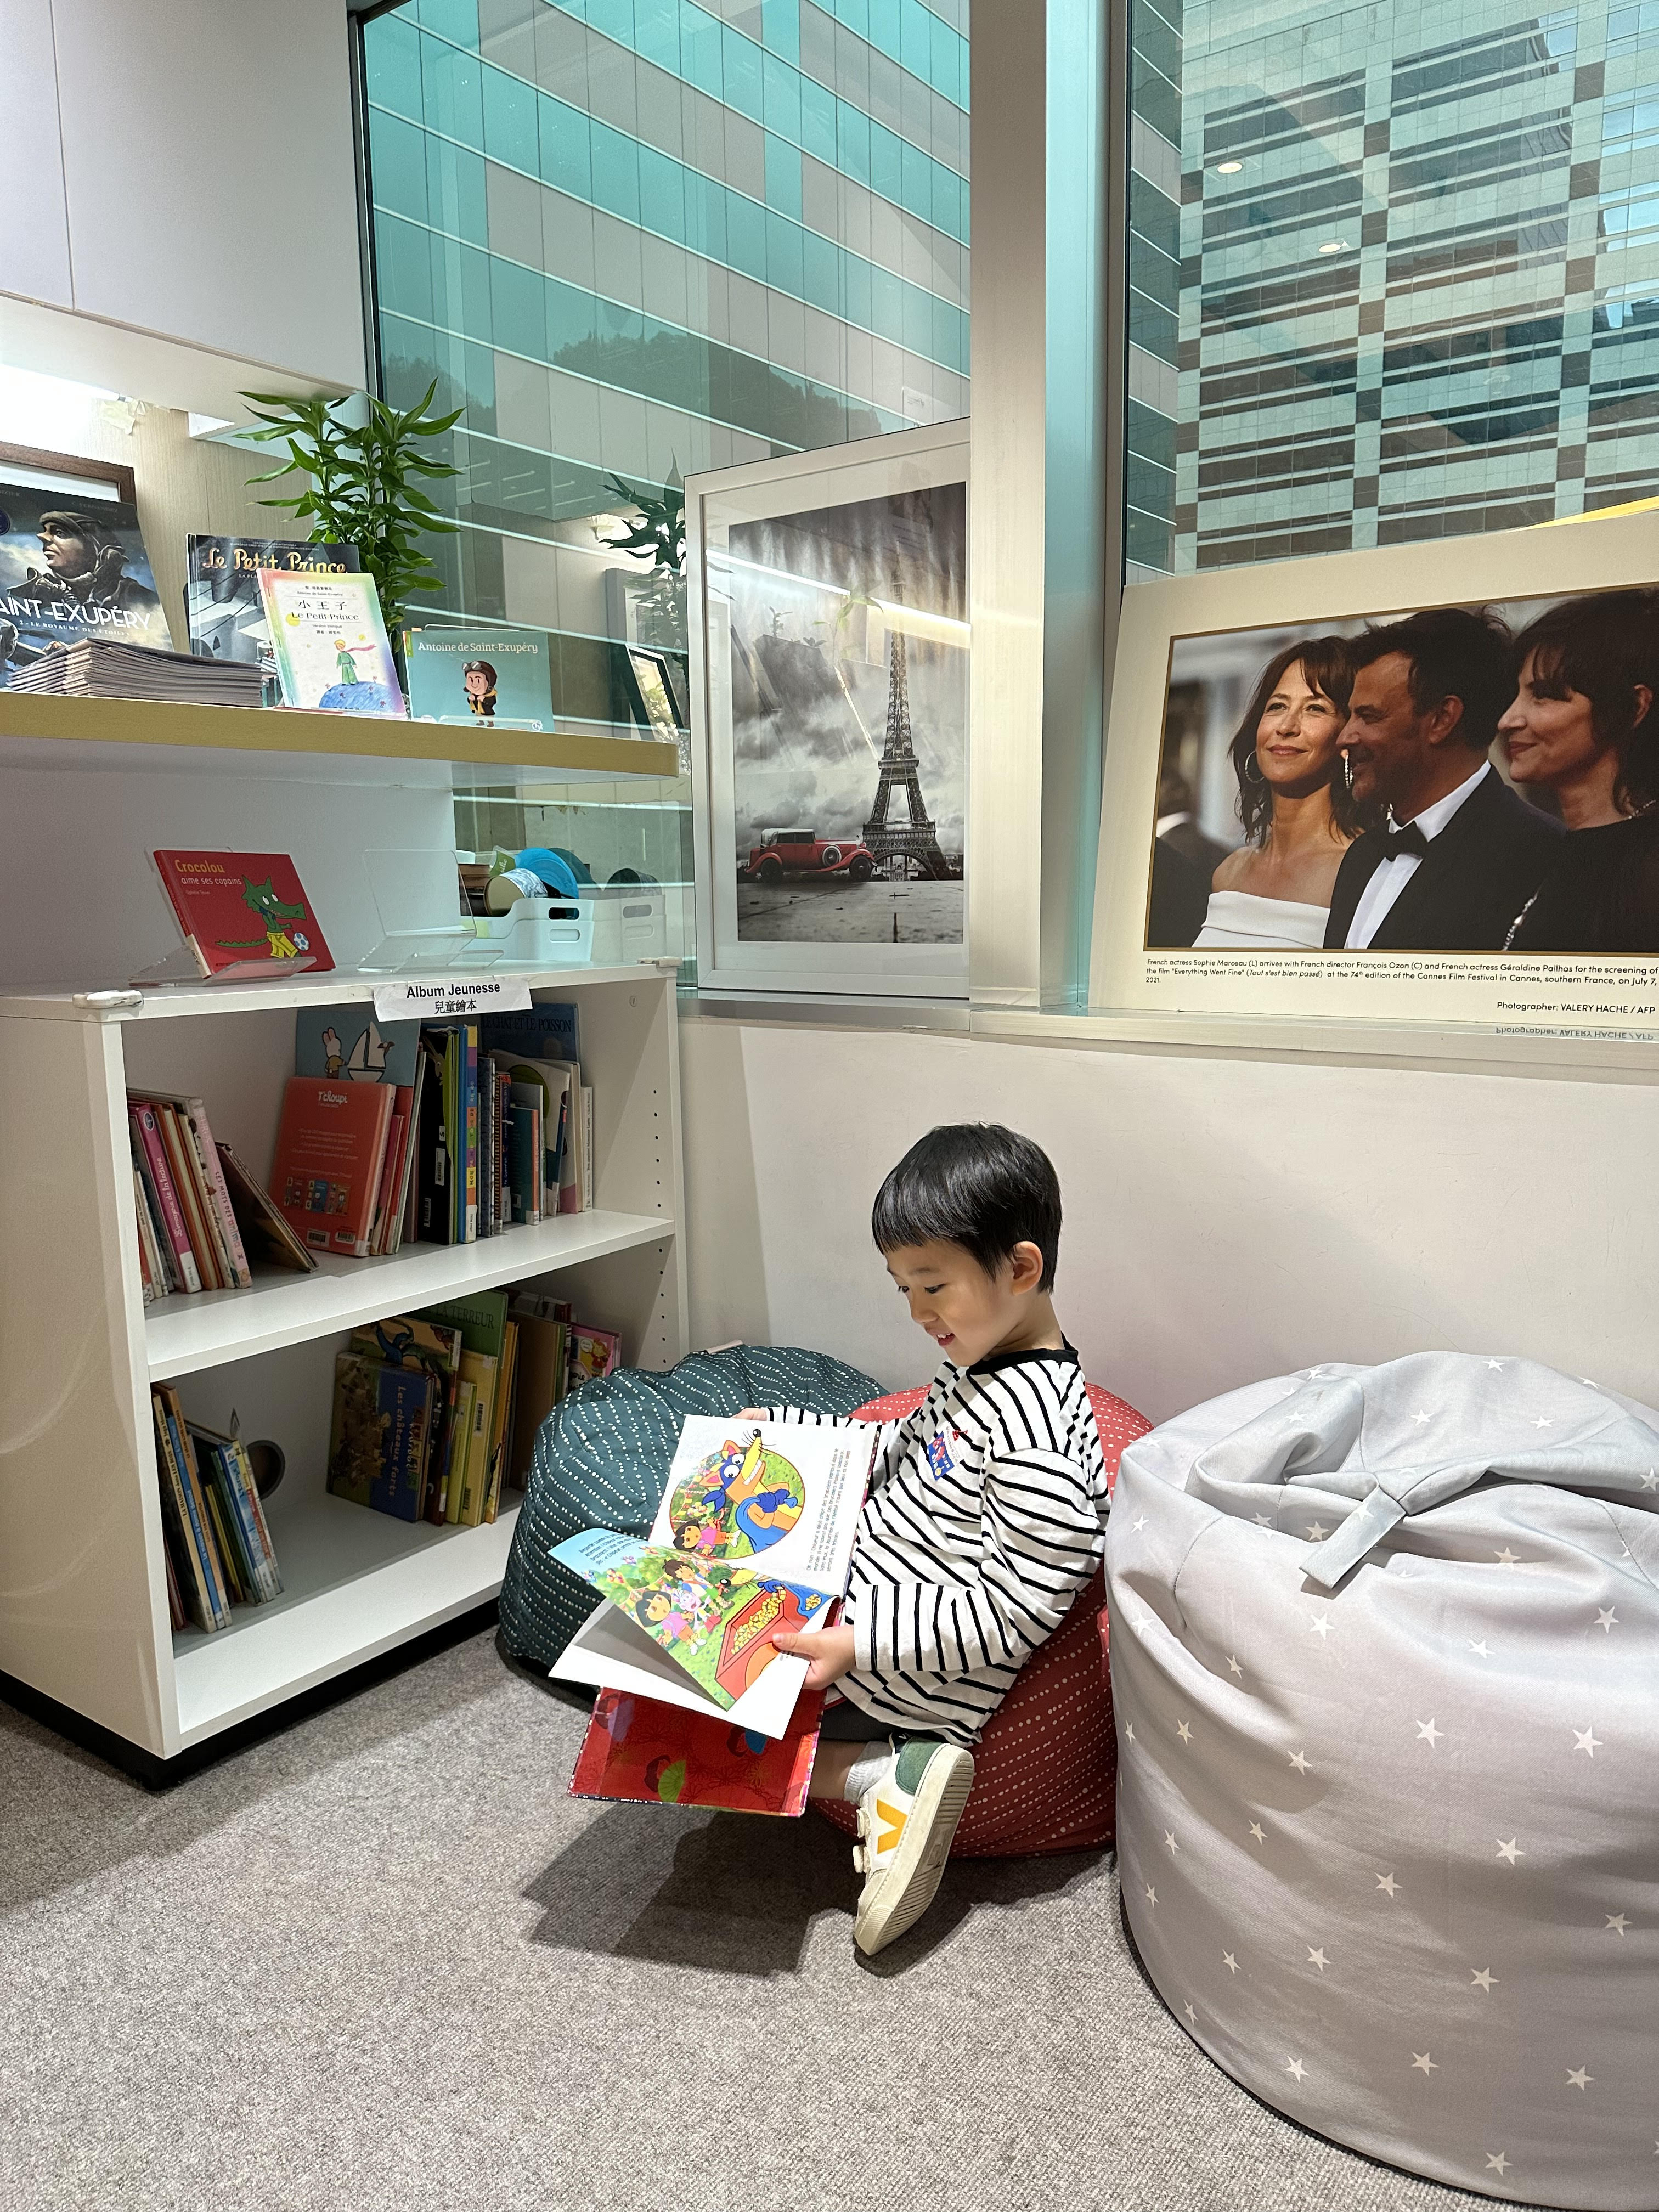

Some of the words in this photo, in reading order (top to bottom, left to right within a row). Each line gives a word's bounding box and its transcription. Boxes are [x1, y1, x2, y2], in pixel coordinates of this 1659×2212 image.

[202, 548, 228, 569] Le
[234, 549, 281, 571] Petit
[287, 552, 347, 573] Prince
[298, 600, 347, 610] 小王子
[0, 596, 150, 630] AINT-EXUPÉRY
[43, 623, 79, 631] ROYAUME
[418, 642, 456, 652] Antoine
[458, 643, 469, 652] de
[470, 642, 538, 654] Saint-Exupéry
[215, 878, 241, 887] copains
[1356, 962, 1387, 970] François
[1500, 963, 1541, 972] Géraldine
[1543, 964, 1573, 973] Pailhas
[1605, 967, 1647, 976] screening
[1171, 968, 1208, 977] "Everything
[1299, 970, 1323, 979] passé)
[1509, 975, 1543, 983] Cannes,
[1584, 977, 1616, 985] France,
[1631, 978, 1649, 986] July
[1650, 979, 1658, 987] 7,
[407, 986, 444, 998] Album
[448, 984, 500, 996] Jeunesse
[435, 998, 477, 1014] 兒童繪本
[1497, 1002, 1559, 1012] Photographer:
[1561, 1003, 1594, 1012] VALERY
[1596, 1005, 1629, 1014] HACHE
[1630, 1006, 1636, 1014] /
[539, 1018, 571, 1032] POISSON
[155, 1156, 167, 1182] lecture
[215, 1171, 223, 1183] LES
[161, 1182, 170, 1191] la
[164, 1191, 172, 1200] de
[218, 1185, 228, 1204] MOTS
[451, 1305, 494, 1329] TERREUR
[397, 1386, 406, 1405] Les
[393, 1409, 405, 1461] châteaux
[389, 1466, 399, 1496] forts
[176, 1487, 185, 1509] MAISON
[181, 1508, 187, 1516] LA
